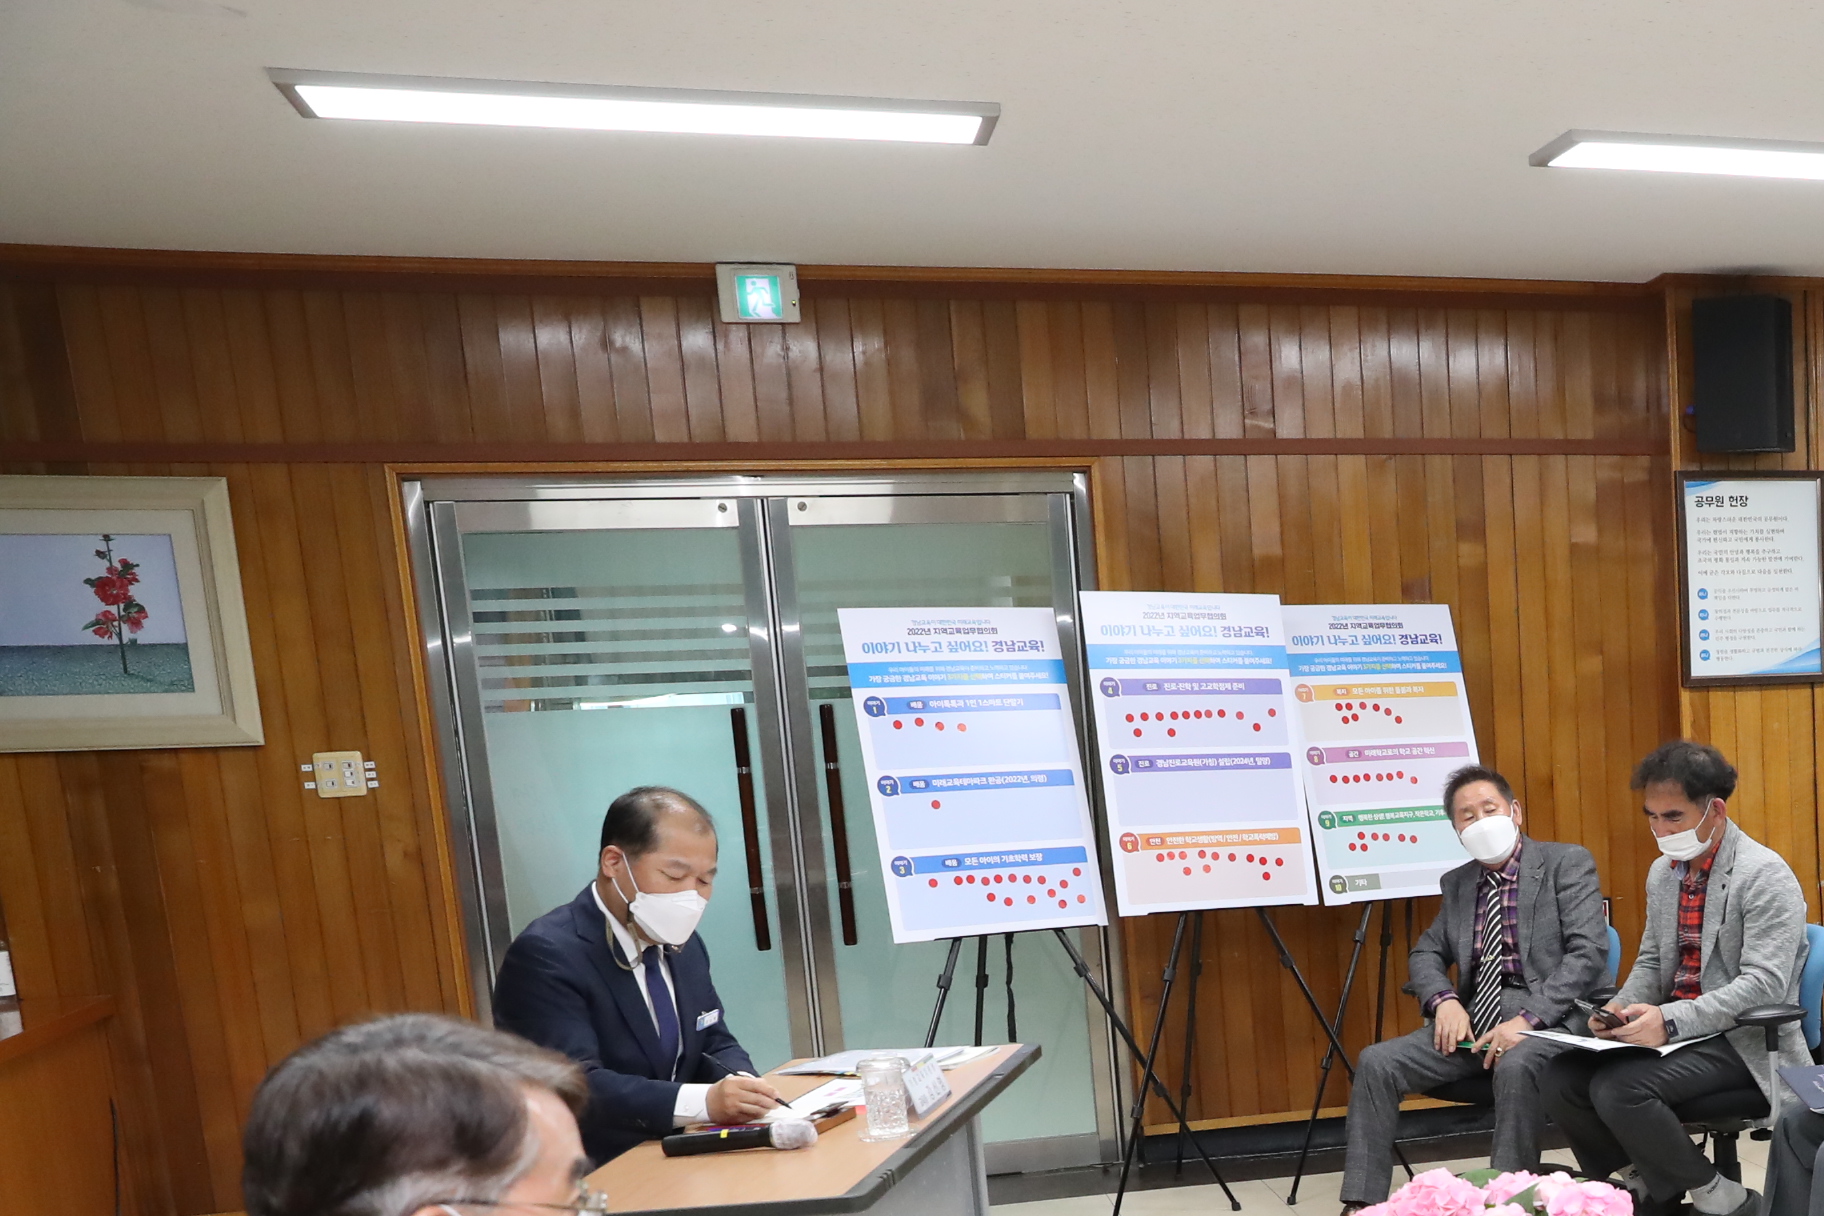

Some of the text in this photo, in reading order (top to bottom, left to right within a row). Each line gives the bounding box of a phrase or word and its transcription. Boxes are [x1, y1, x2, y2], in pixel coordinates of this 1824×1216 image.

[1695, 495, 1749, 508] 공무원 헌장
[1142, 611, 1165, 620] 2022년
[1328, 622, 1348, 630] 2022년
[907, 627, 998, 636] 2022년 지역교육업무협의회
[1100, 624, 1270, 638] 이야기 나누고 싶어요! 경남교육!
[1292, 633, 1443, 646] 이야기 나누고 싶어요! 경남교육!
[861, 640, 1046, 654] 이야기 나누고 싶어요! 경남교육!
[1105, 657, 1118, 665] 가장
[1118, 657, 1136, 665] 궁금한
[1137, 657, 1160, 665] 경남교육
[1326, 664, 1346, 672] 경남교육
[869, 675, 882, 683] 가장
[883, 675, 902, 683] 궁금한
[902, 674, 927, 682] 경남교육
[928, 674, 946, 682] 이야기
[872, 706, 877, 714] 1
[1127, 842, 1133, 850] 6
[964, 857, 978, 866] 모든
[899, 866, 905, 874] 3
[1354, 878, 1368, 886] 기타
[1334, 883, 1342, 891] 10
